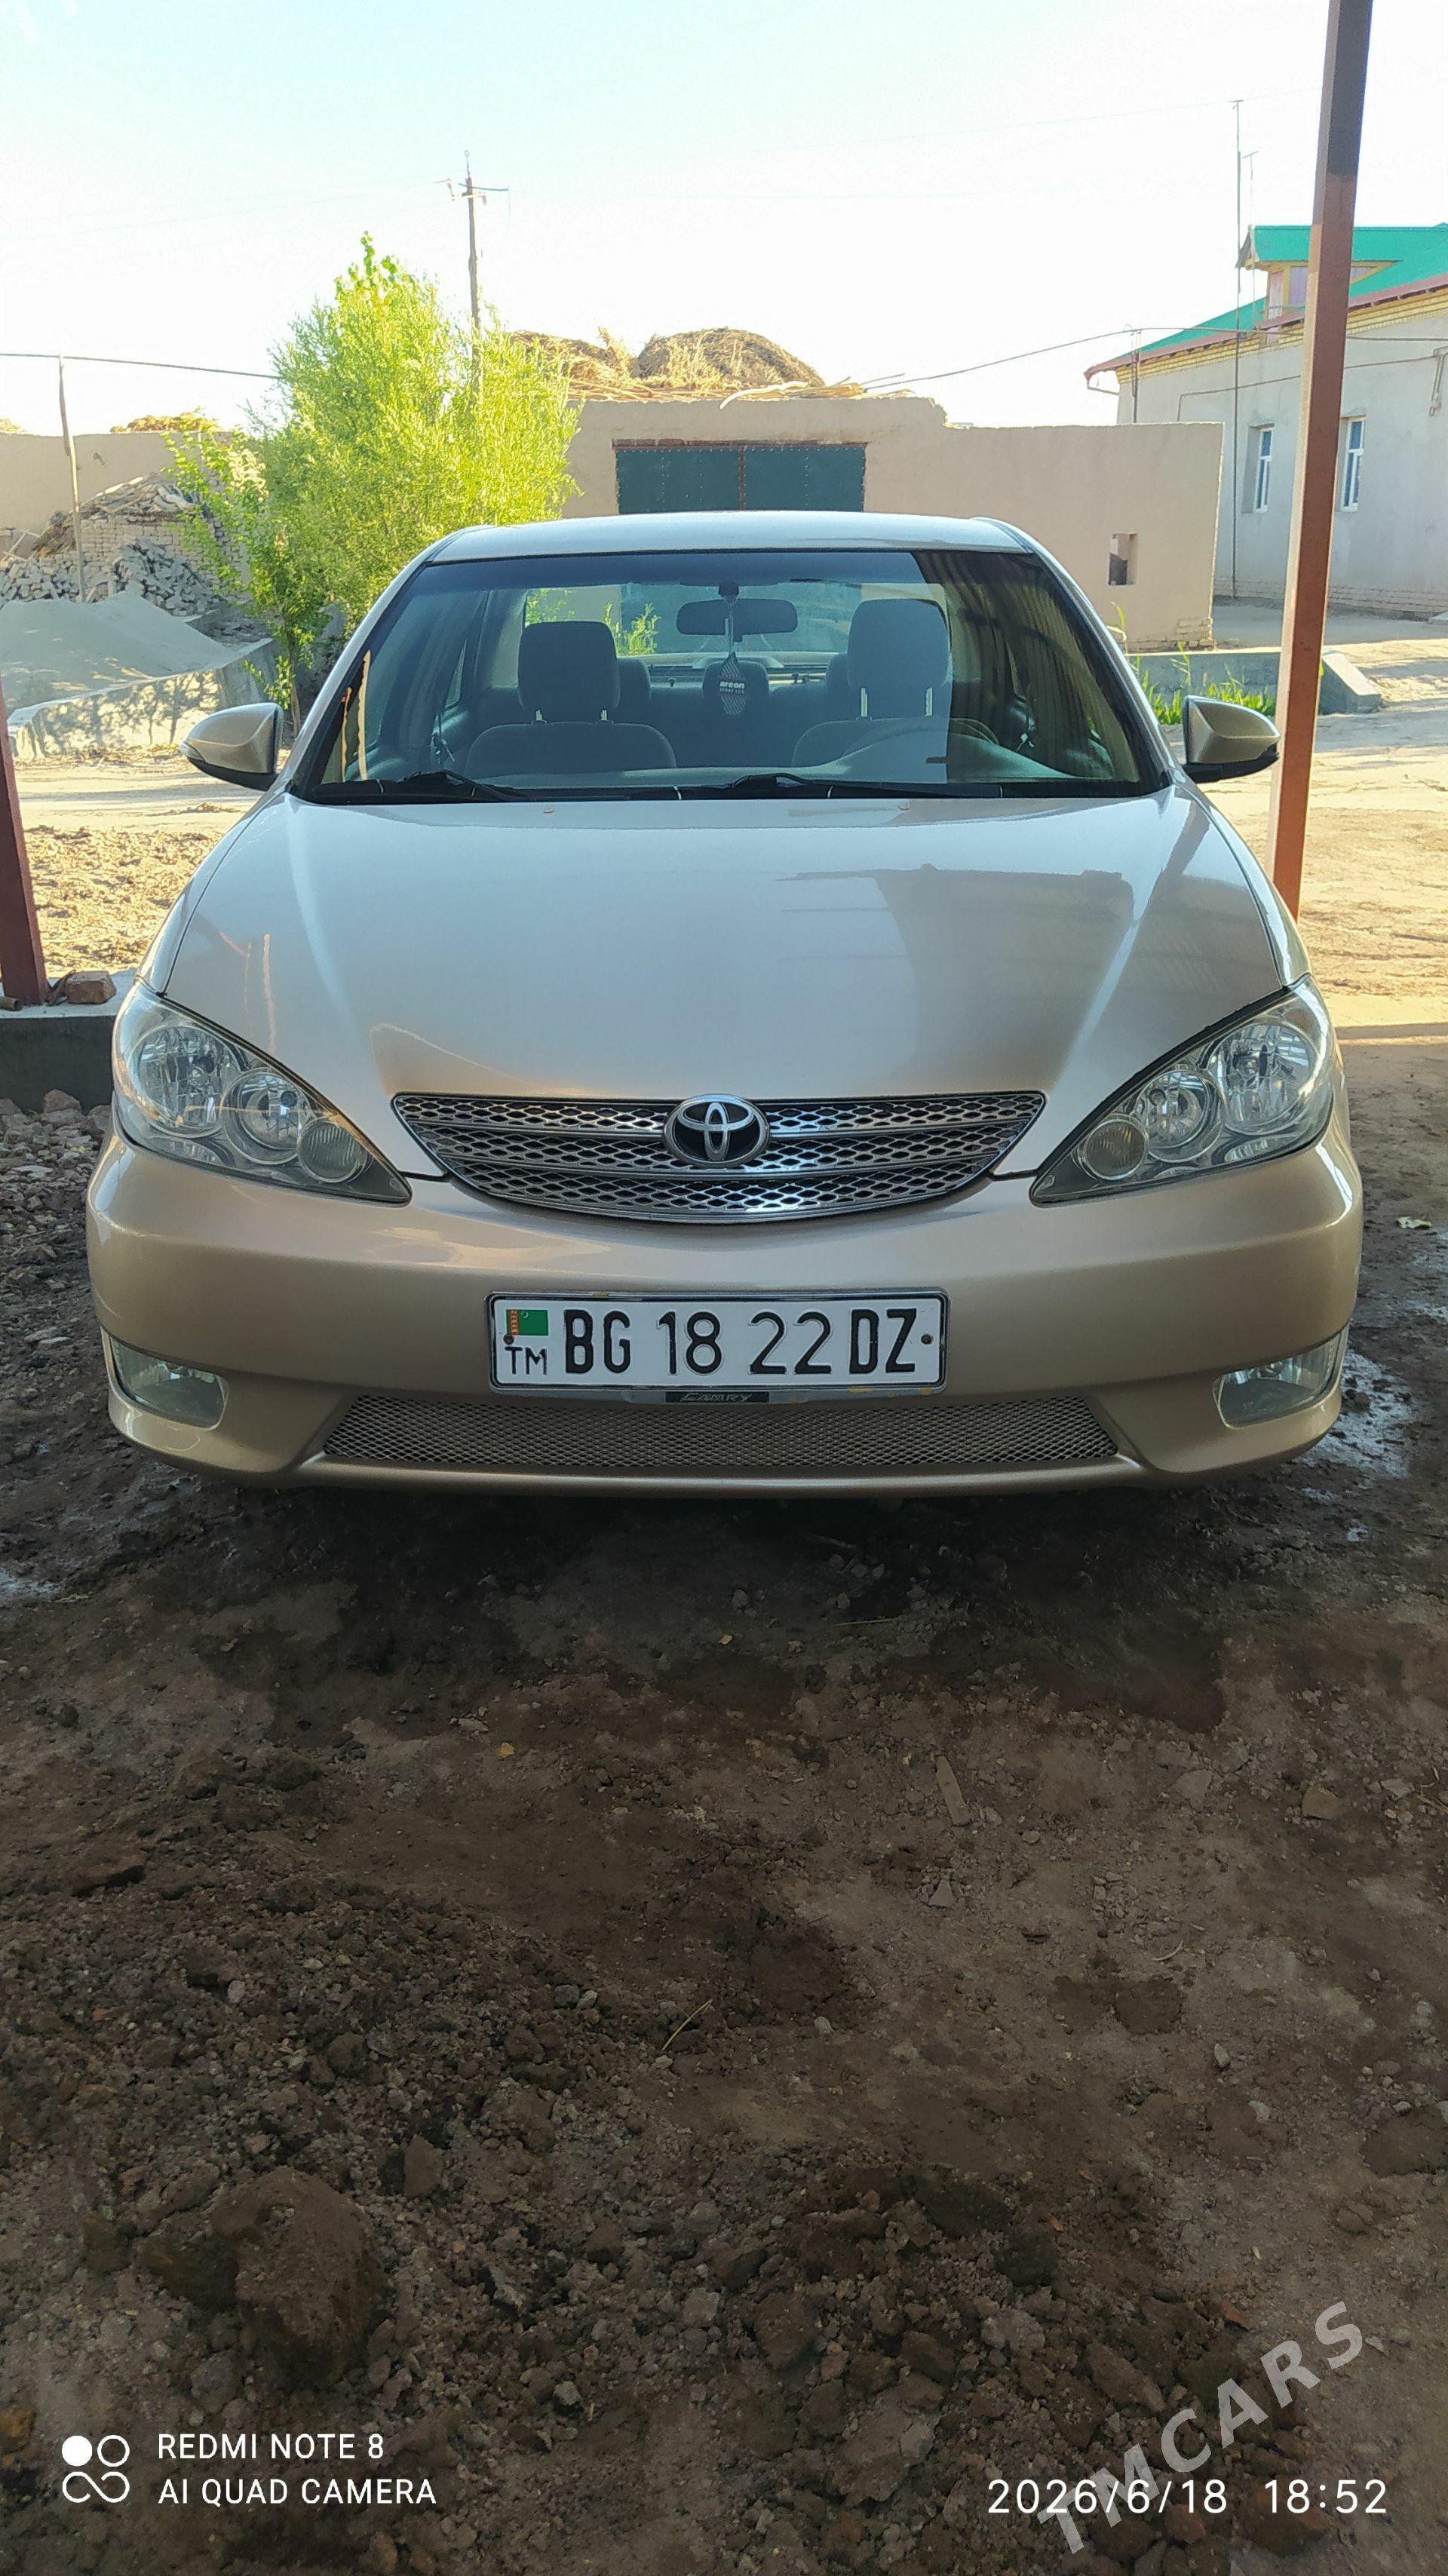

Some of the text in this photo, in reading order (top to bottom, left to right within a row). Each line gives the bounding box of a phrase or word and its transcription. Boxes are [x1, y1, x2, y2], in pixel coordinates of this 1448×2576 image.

[719, 681, 745, 689] areon
[505, 1308, 917, 1375] TM BG 18 22 DZ
[680, 1392, 753, 1403] CAMRY
